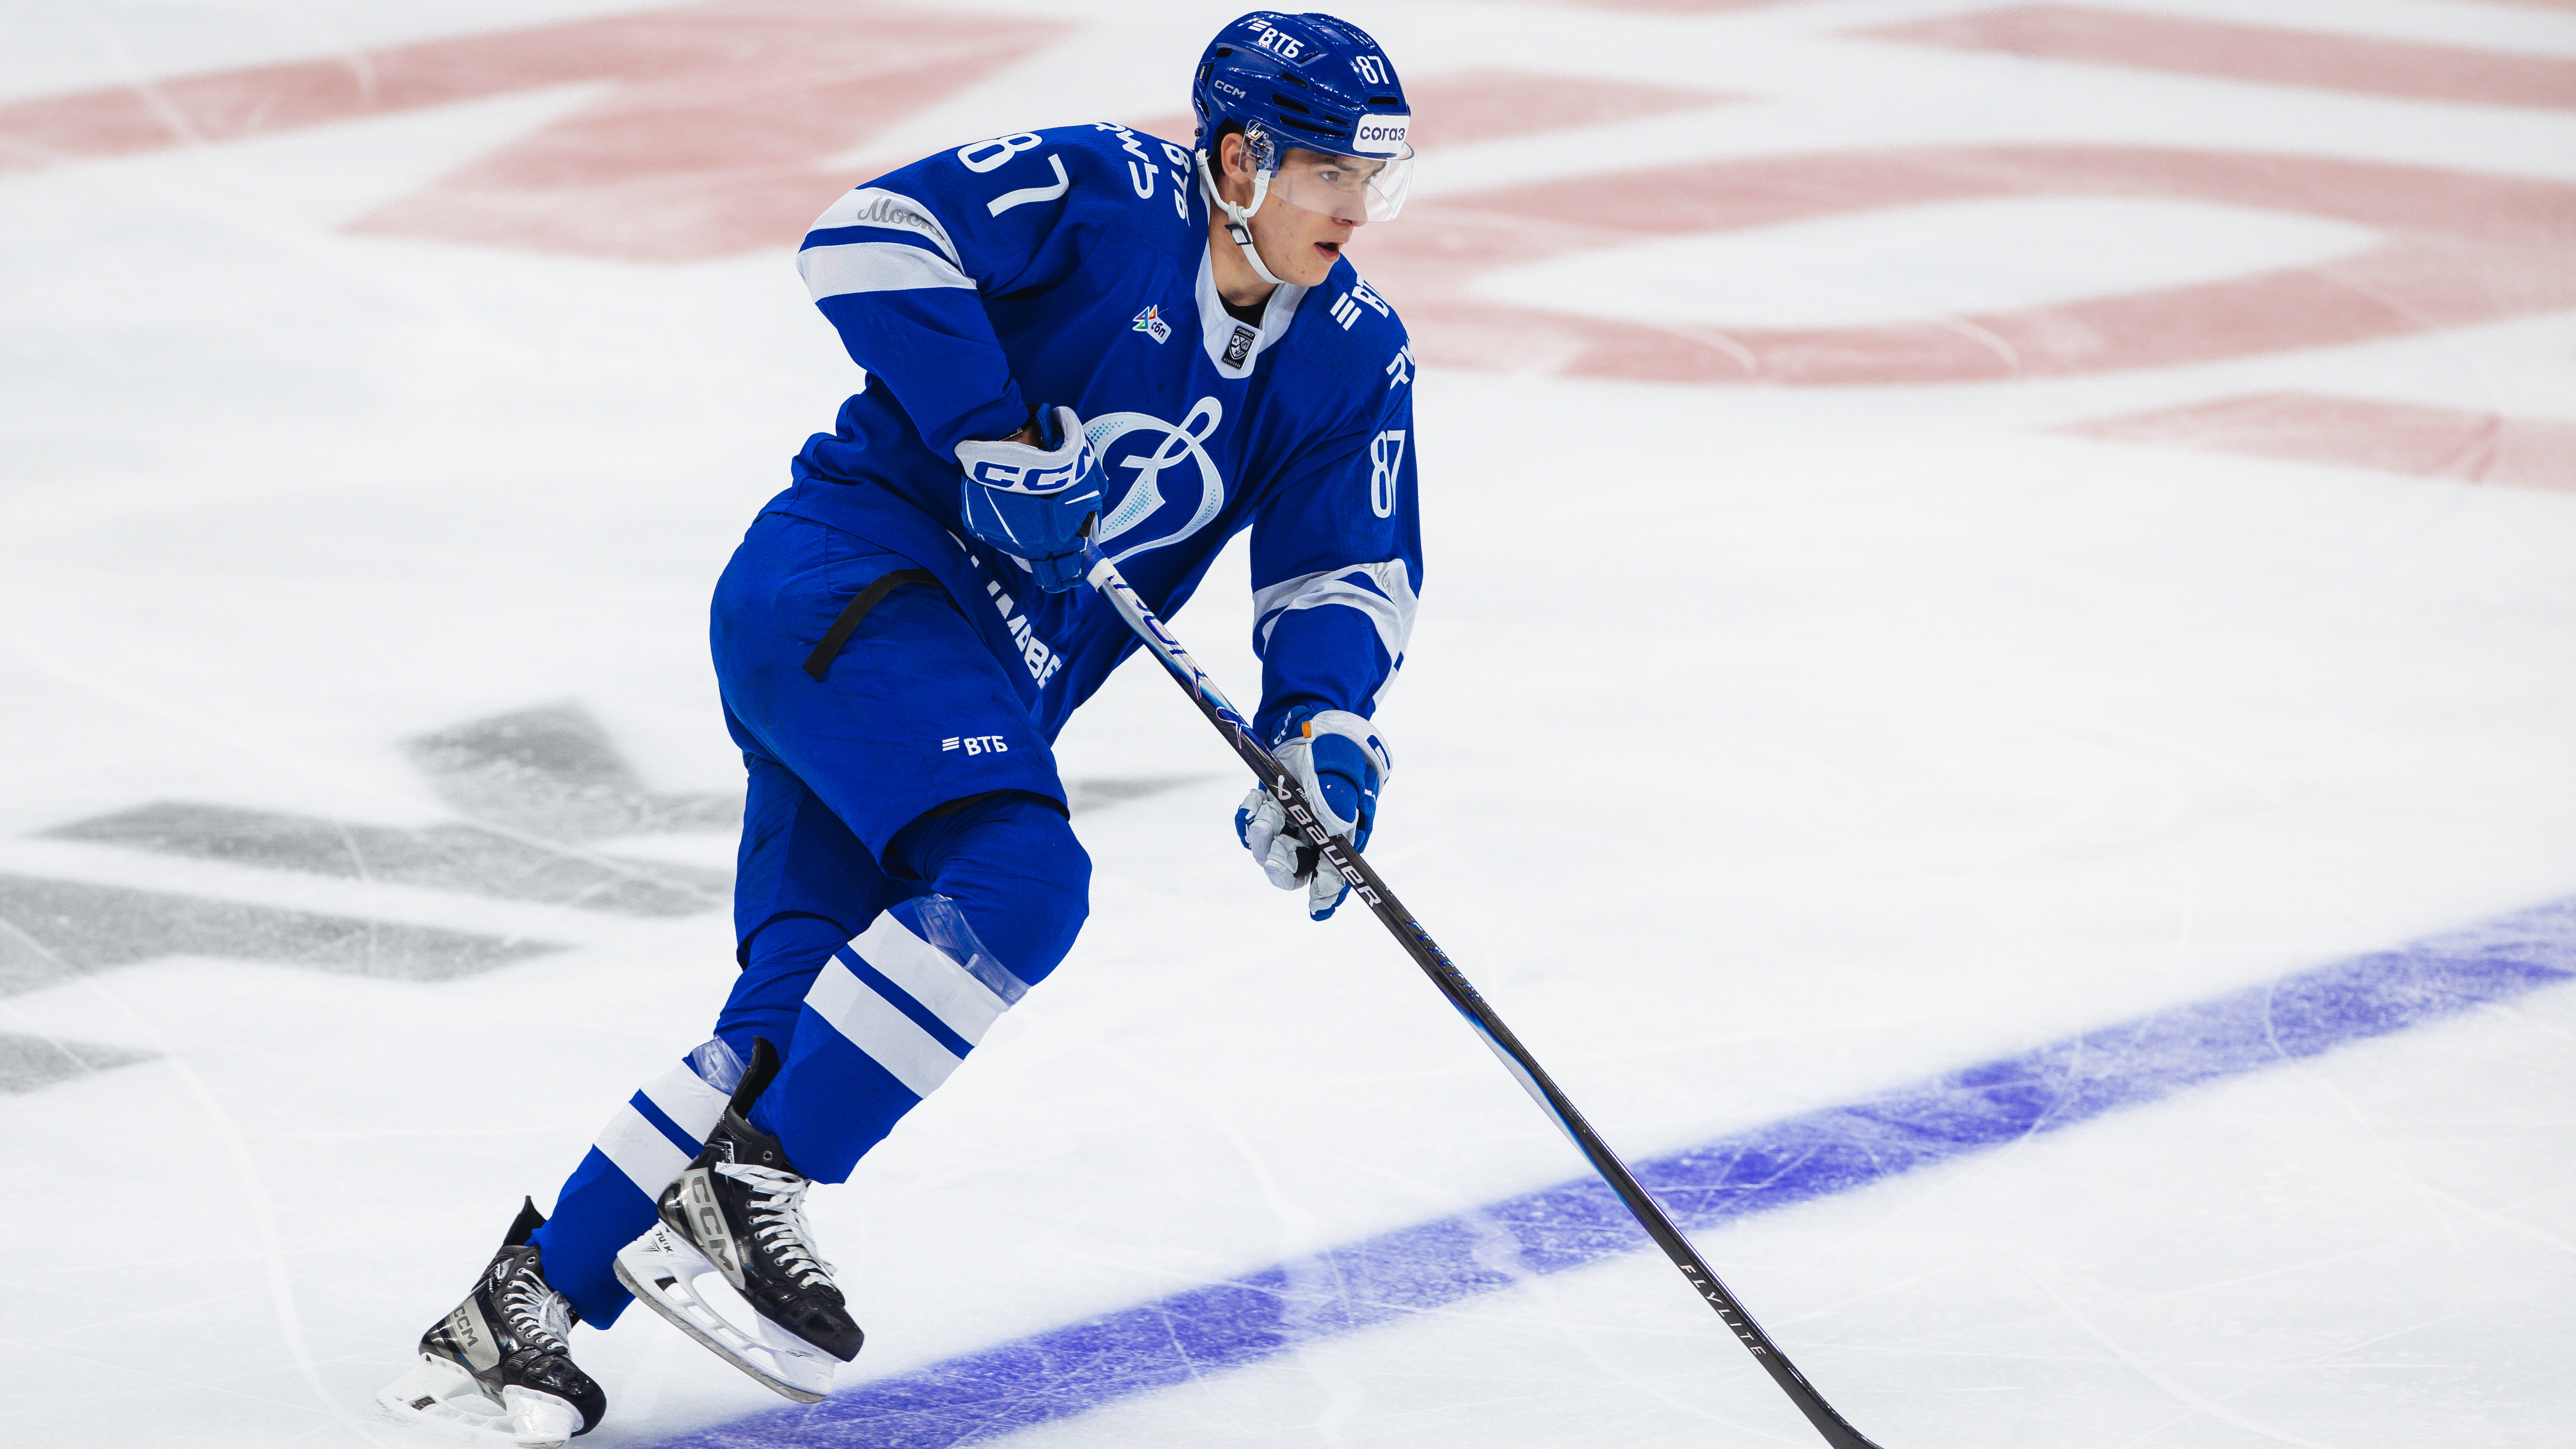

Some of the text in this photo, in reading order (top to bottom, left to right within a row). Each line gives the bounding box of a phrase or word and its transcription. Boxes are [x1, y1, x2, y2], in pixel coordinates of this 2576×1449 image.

[1257, 27, 1305, 58] ВТБ
[1356, 56, 1390, 84] 87
[1214, 80, 1246, 99] CCM
[1360, 126, 1405, 141] согаз
[957, 132, 1069, 217] 87
[1237, 327, 1254, 337] FONBET
[1371, 429, 1406, 518] 87
[964, 735, 1008, 756] ВТБ
[691, 1175, 735, 1271] CCM
[1680, 1264, 1766, 1356] FLYLITE
[454, 1306, 479, 1347] CCM
